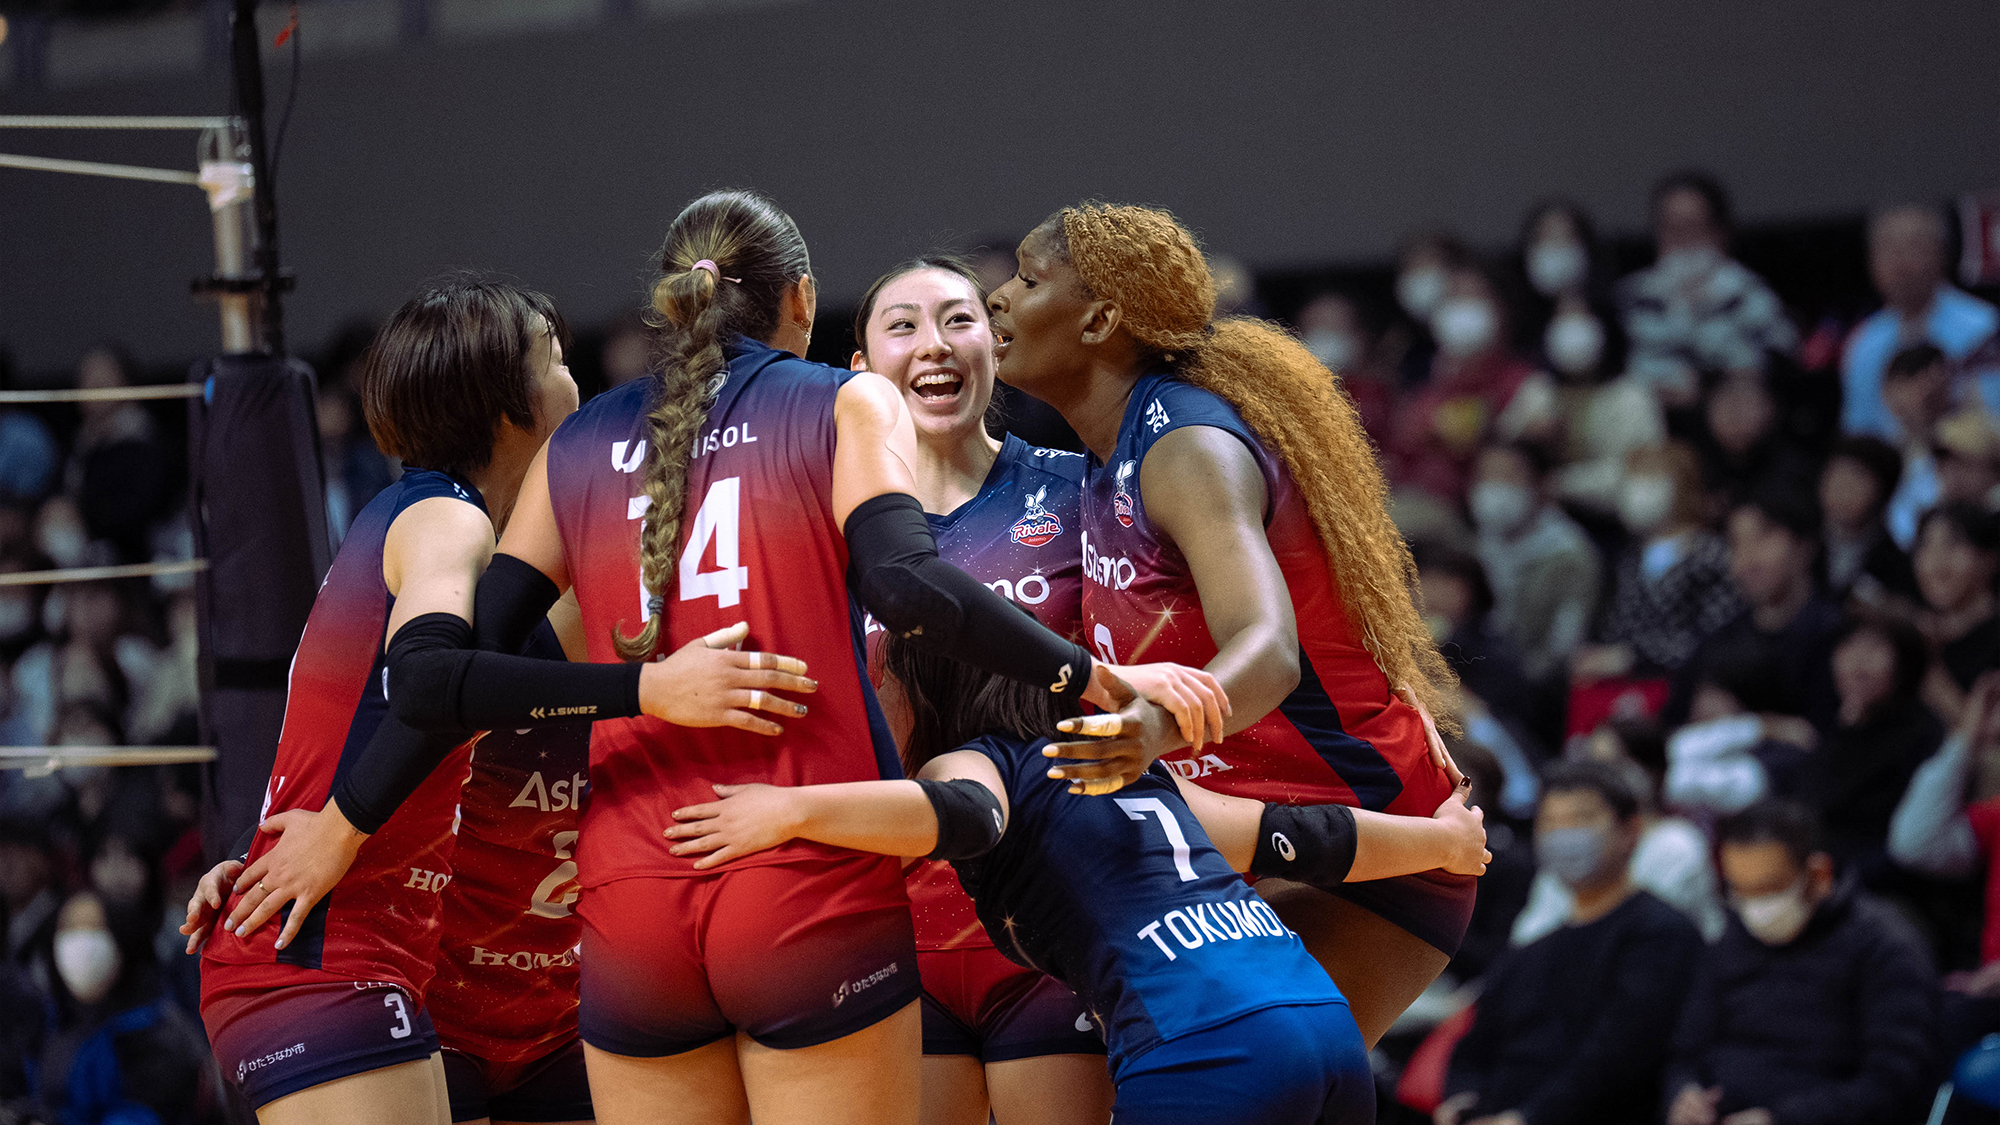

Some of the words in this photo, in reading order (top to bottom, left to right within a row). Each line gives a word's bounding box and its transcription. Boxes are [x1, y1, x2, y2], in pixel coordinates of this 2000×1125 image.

[1011, 521, 1061, 541] Rivale
[1113, 797, 1200, 883] 7
[851, 962, 898, 993] ひたちなか市
[384, 992, 412, 1039] 3
[248, 1043, 306, 1071] ひたちなか市
